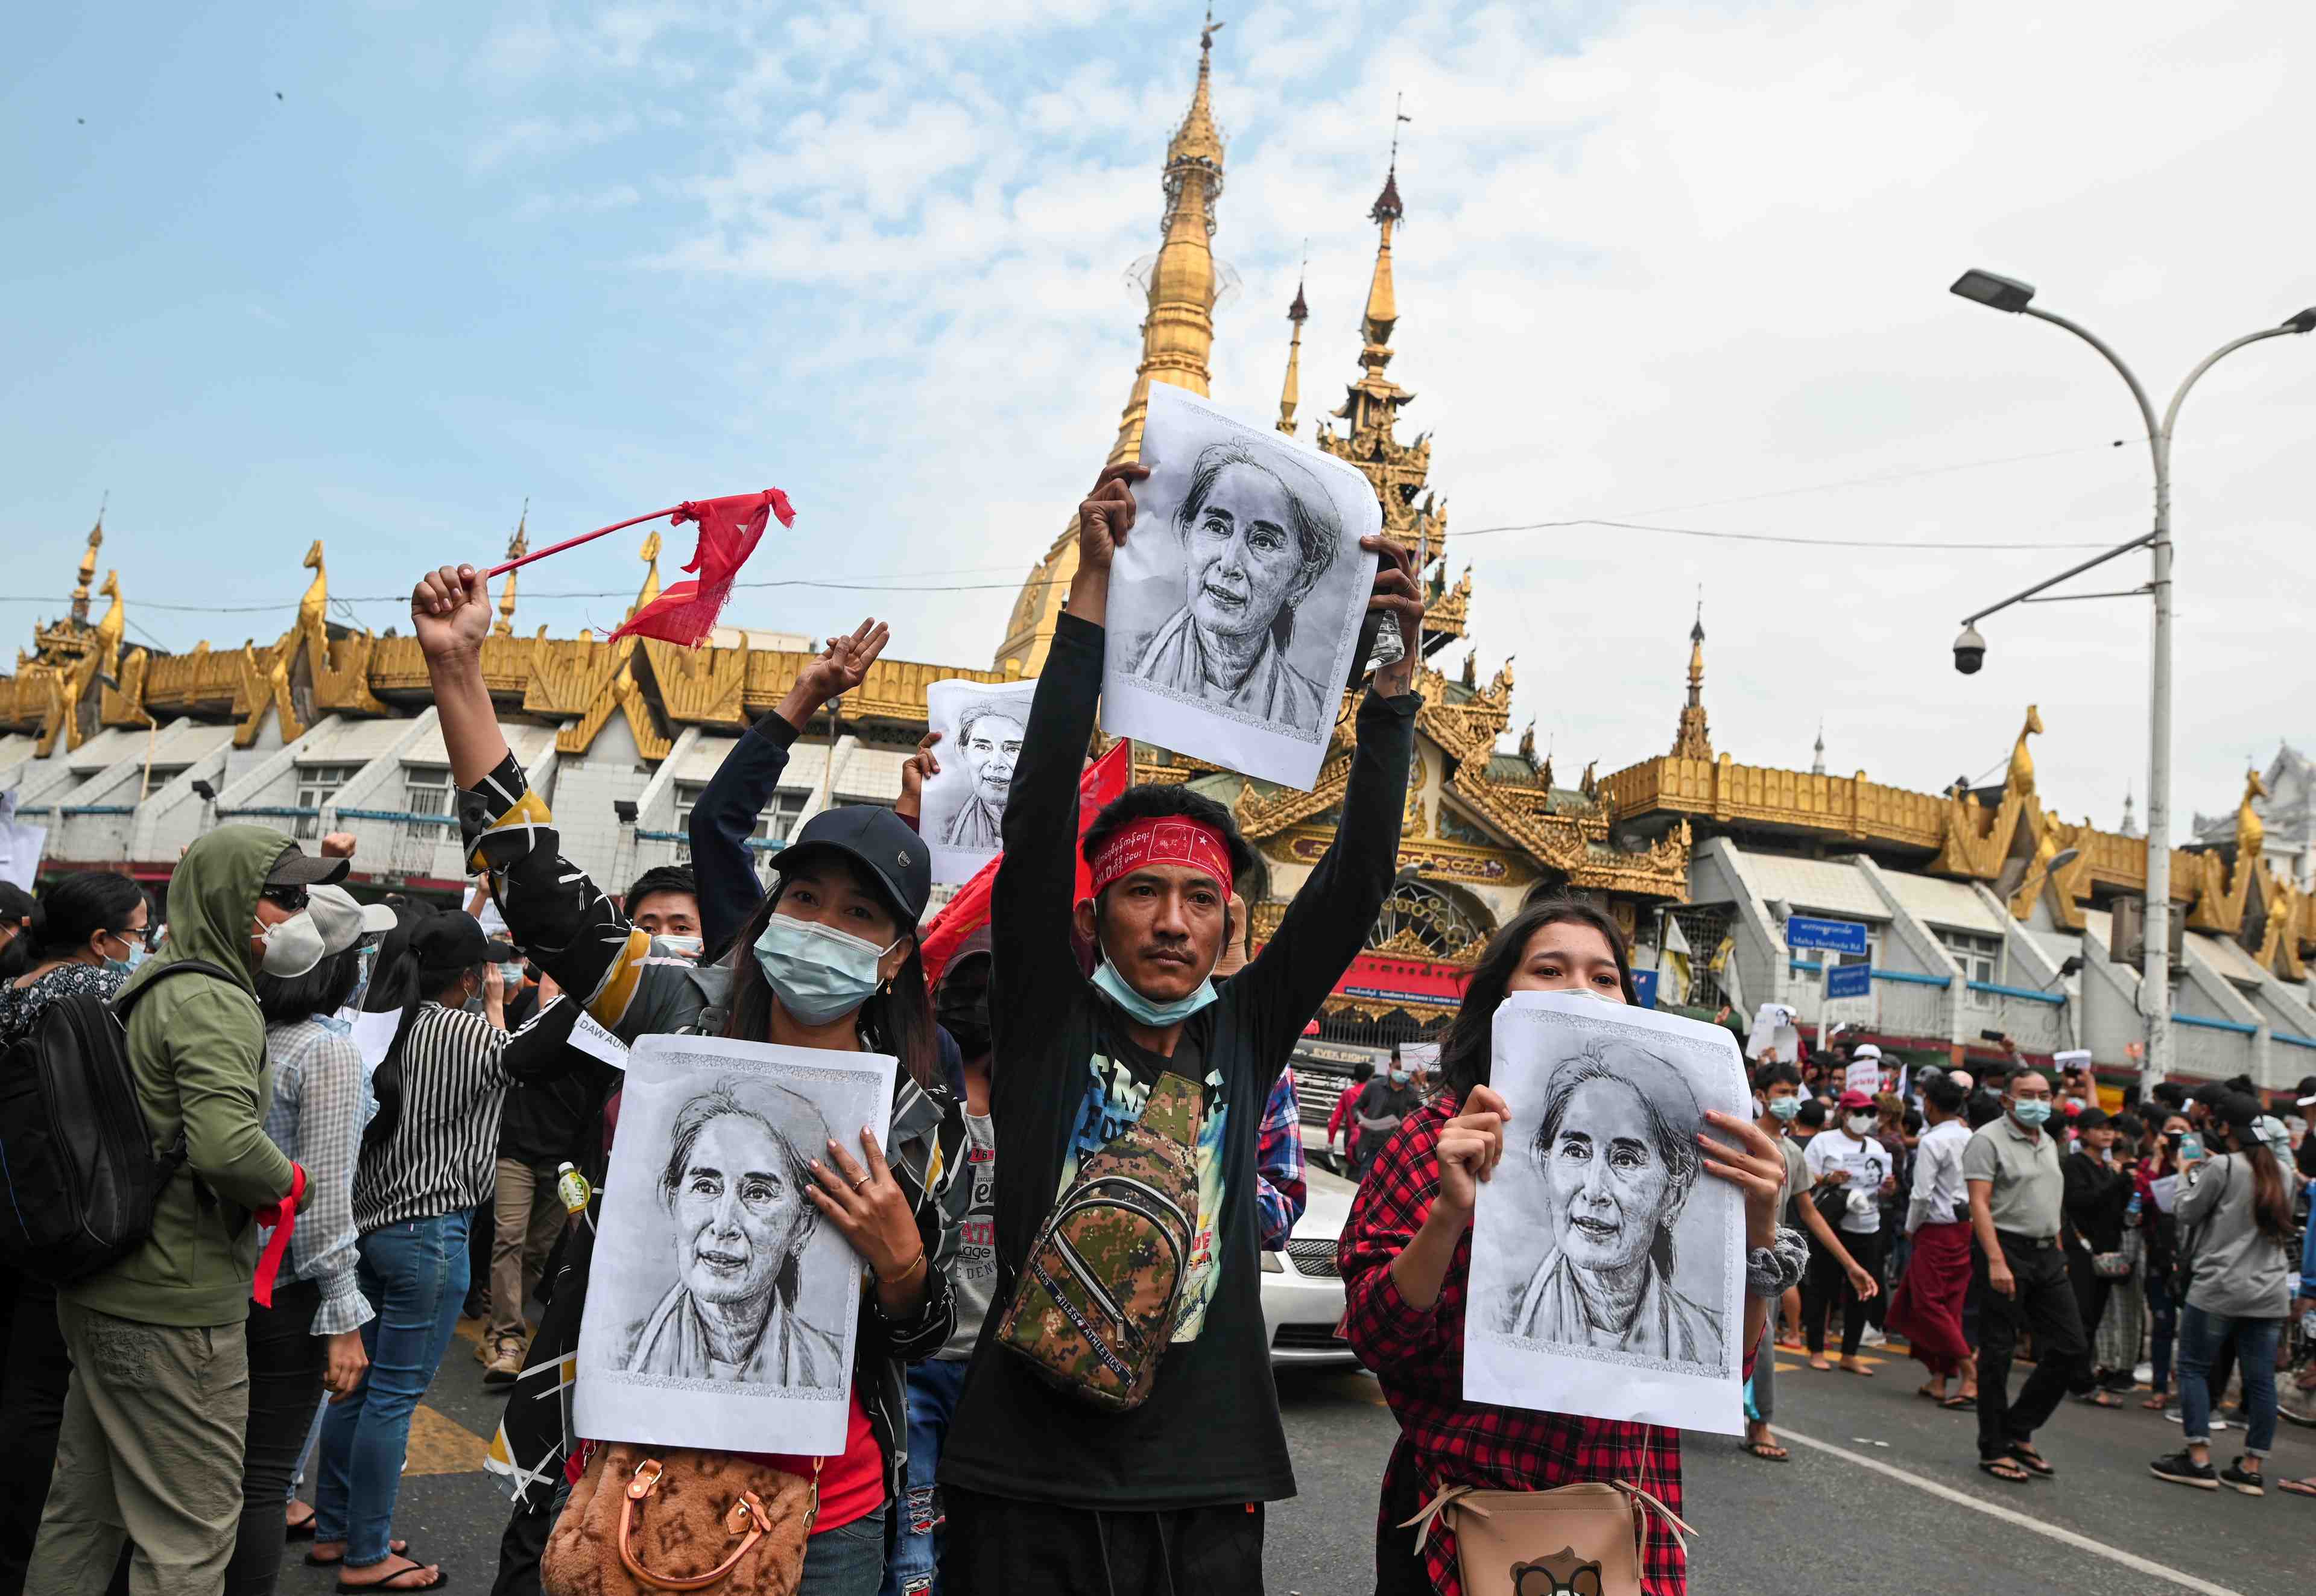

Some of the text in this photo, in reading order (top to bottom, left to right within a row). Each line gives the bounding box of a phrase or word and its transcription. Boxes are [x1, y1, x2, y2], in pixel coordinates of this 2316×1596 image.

[579, 1019, 630, 1054] DAW AUN
[962, 1246, 991, 1260] age
[1083, 1327, 1122, 1373] ATHLETICS
